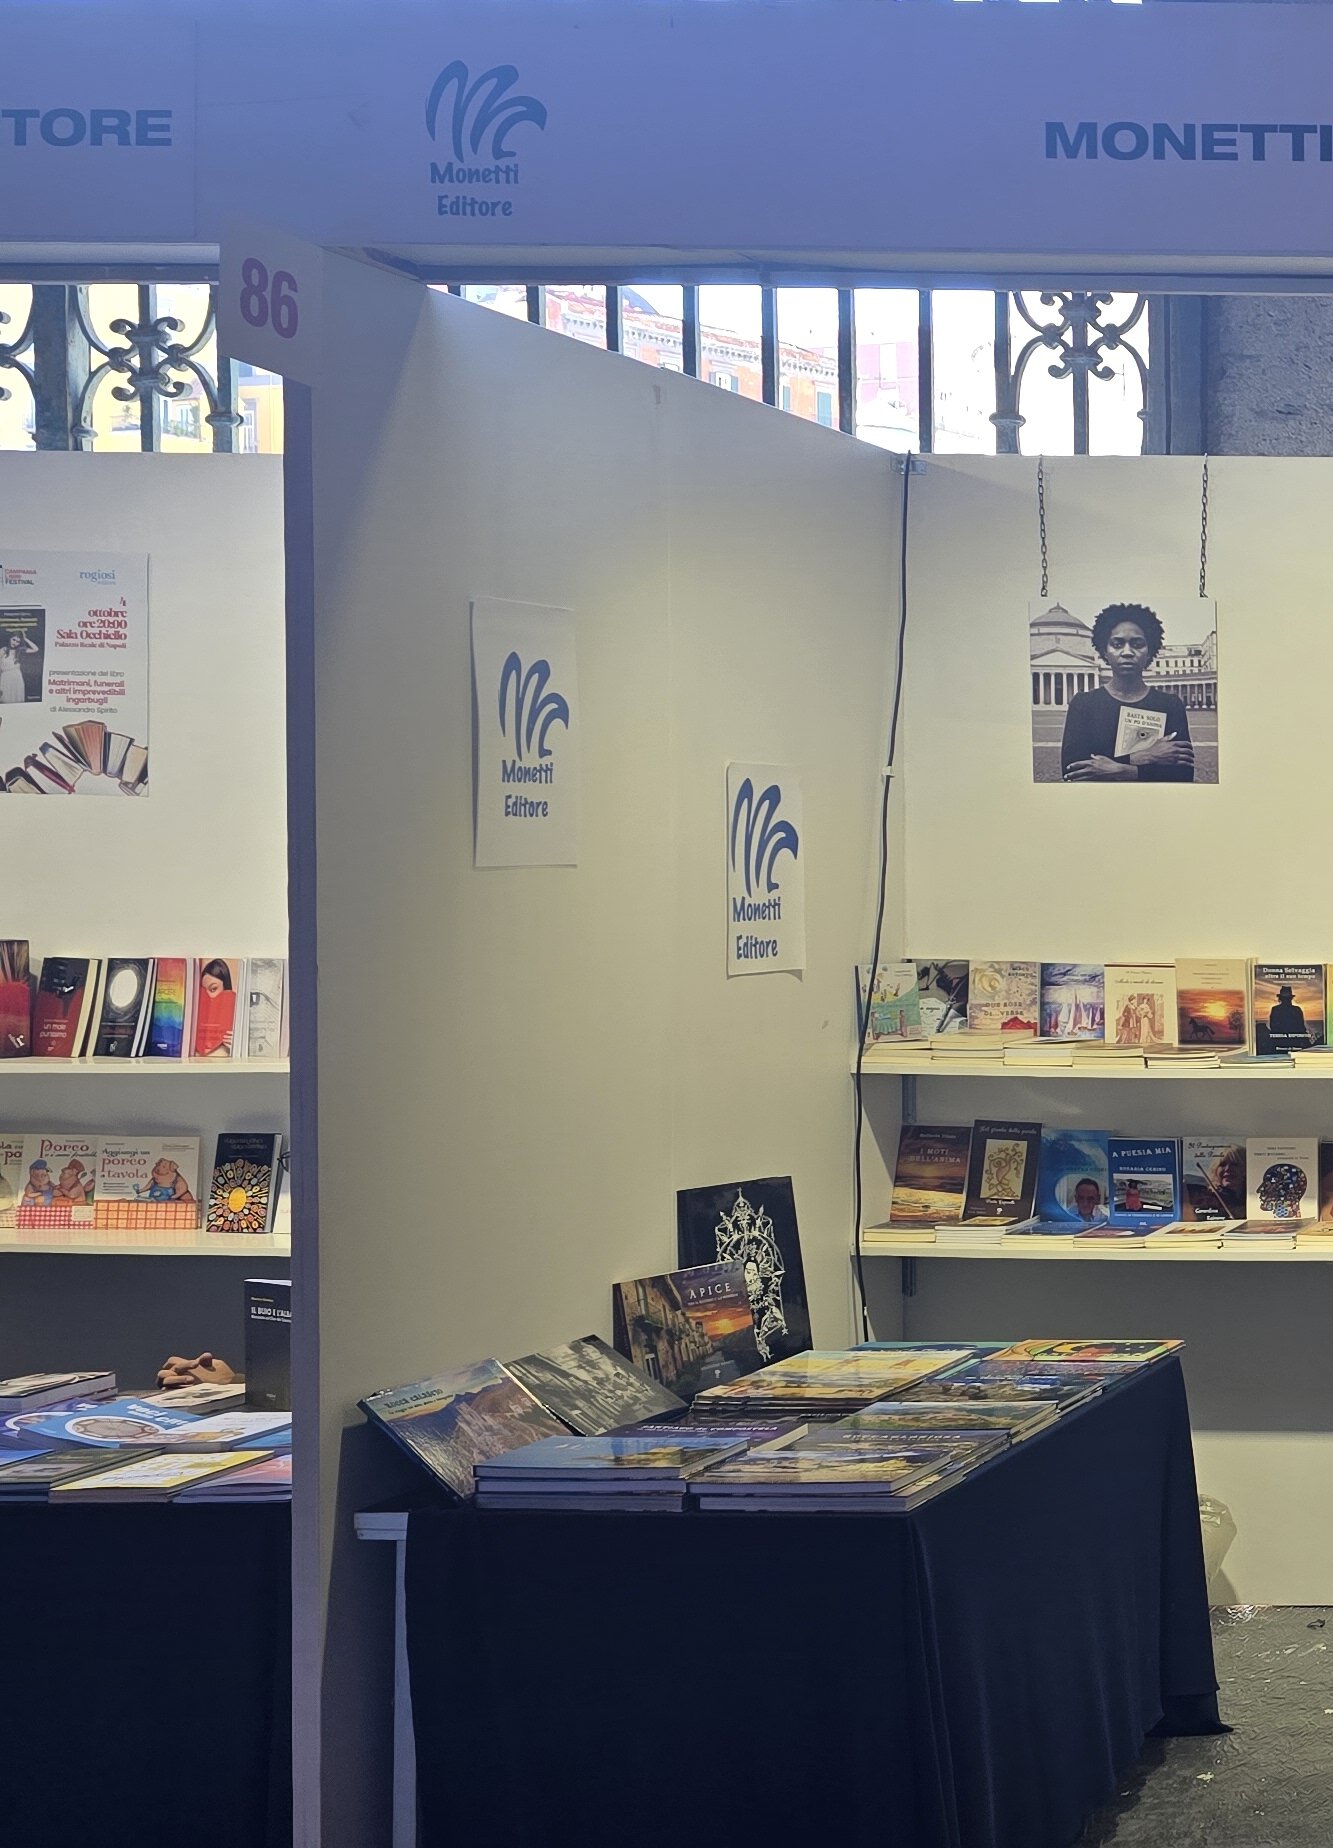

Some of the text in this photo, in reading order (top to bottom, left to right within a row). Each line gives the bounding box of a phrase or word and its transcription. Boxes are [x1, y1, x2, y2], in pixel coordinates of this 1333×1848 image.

[1, 108, 172, 147] TORE
[1043, 122, 1333, 161] MONETTI
[430, 162, 519, 186] Monetti
[437, 195, 513, 218] Editore
[240, 257, 299, 338] 86
[79, 569, 116, 583] rogiosi
[88, 608, 127, 618] ottobre
[502, 759, 553, 784] Monetti
[504, 795, 549, 818] Editore
[732, 896, 782, 922] Monetti
[736, 935, 778, 960] Editore
[40, 1139, 90, 1158] Porco
[101, 1157, 146, 1172] porco
[108, 1168, 148, 1179] tavola
[689, 1282, 732, 1300] APICE
